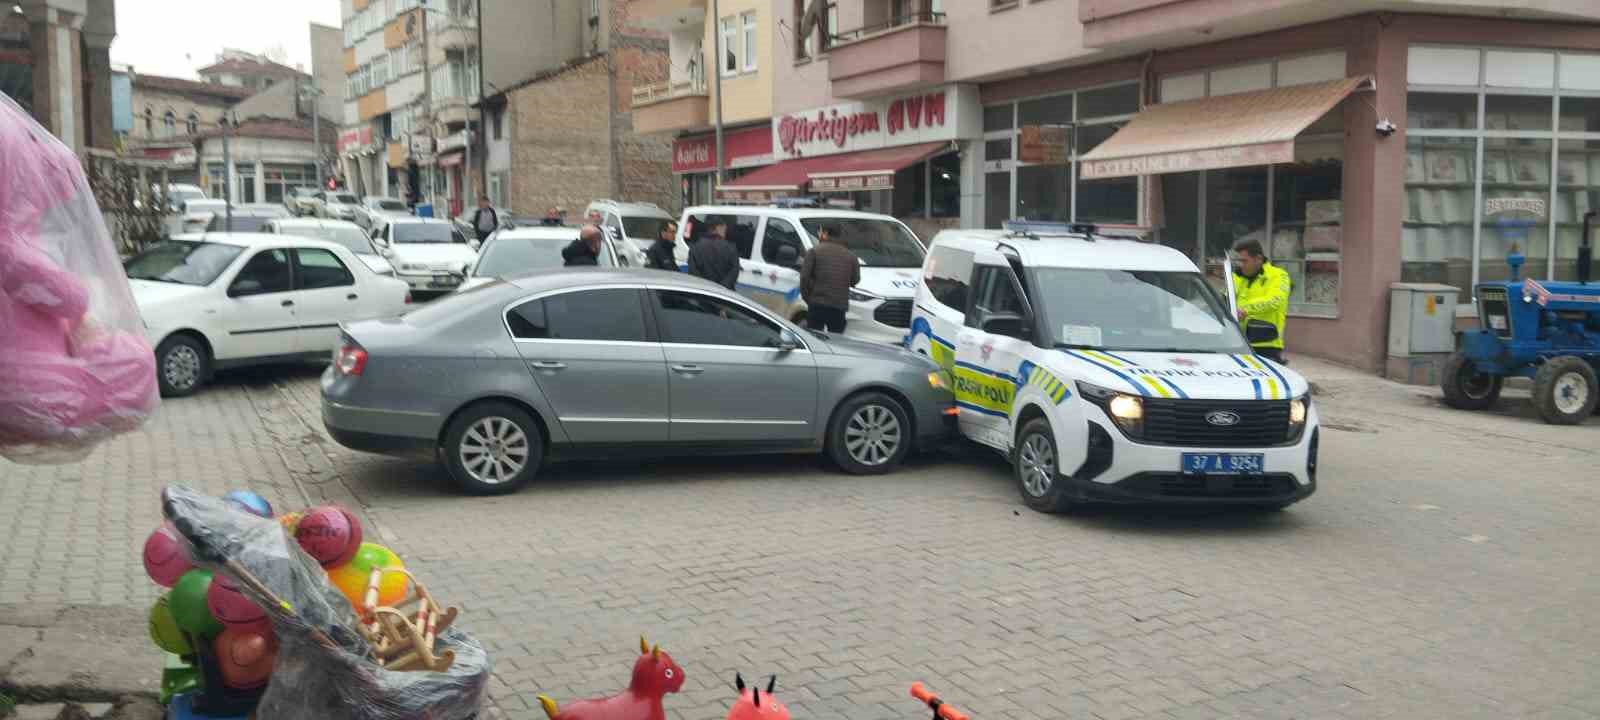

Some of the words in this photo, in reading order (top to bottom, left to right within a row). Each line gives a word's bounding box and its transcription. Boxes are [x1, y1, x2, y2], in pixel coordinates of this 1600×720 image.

[887, 93, 945, 135] AVM
[1192, 455, 1208, 470] 37
[1215, 456, 1223, 470] A
[1230, 456, 1260, 470] 9254
